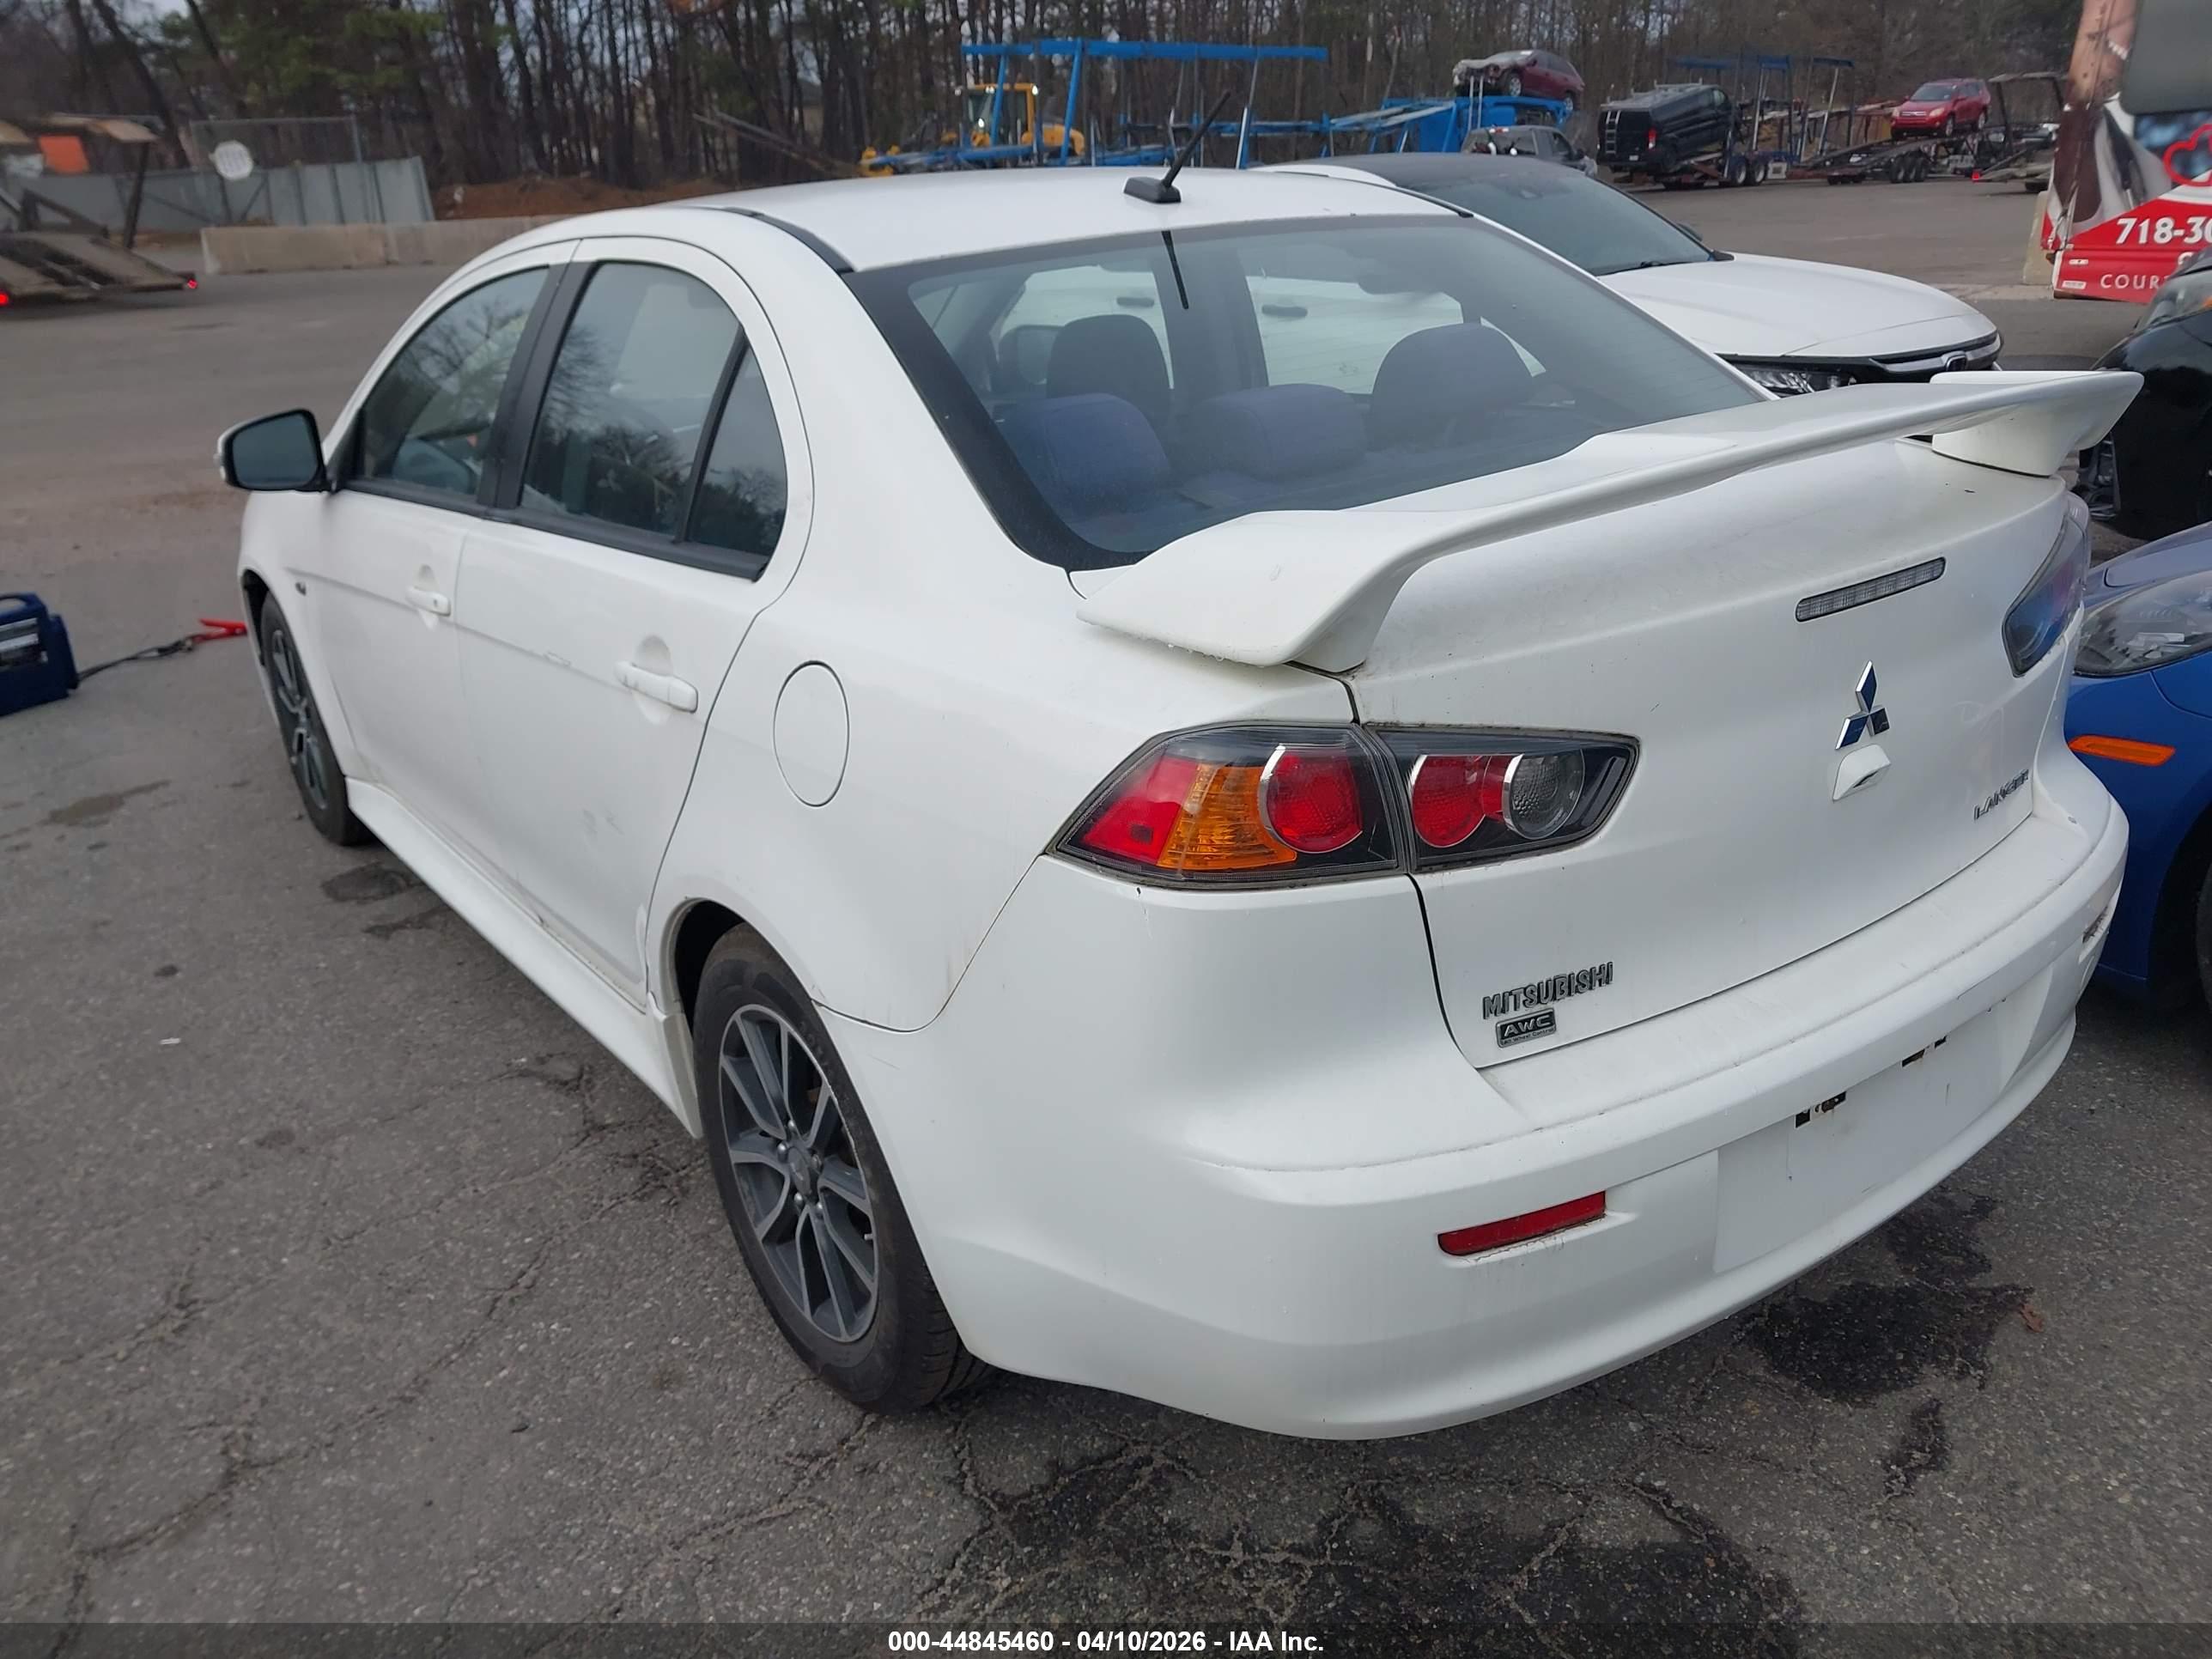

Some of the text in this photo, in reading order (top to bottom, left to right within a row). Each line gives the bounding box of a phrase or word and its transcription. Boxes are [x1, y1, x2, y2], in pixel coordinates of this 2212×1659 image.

[2100, 274, 2170, 289] COUR
[1483, 962, 1613, 1019] MITSUBISHI
[1504, 1014, 1552, 1037] AWC
